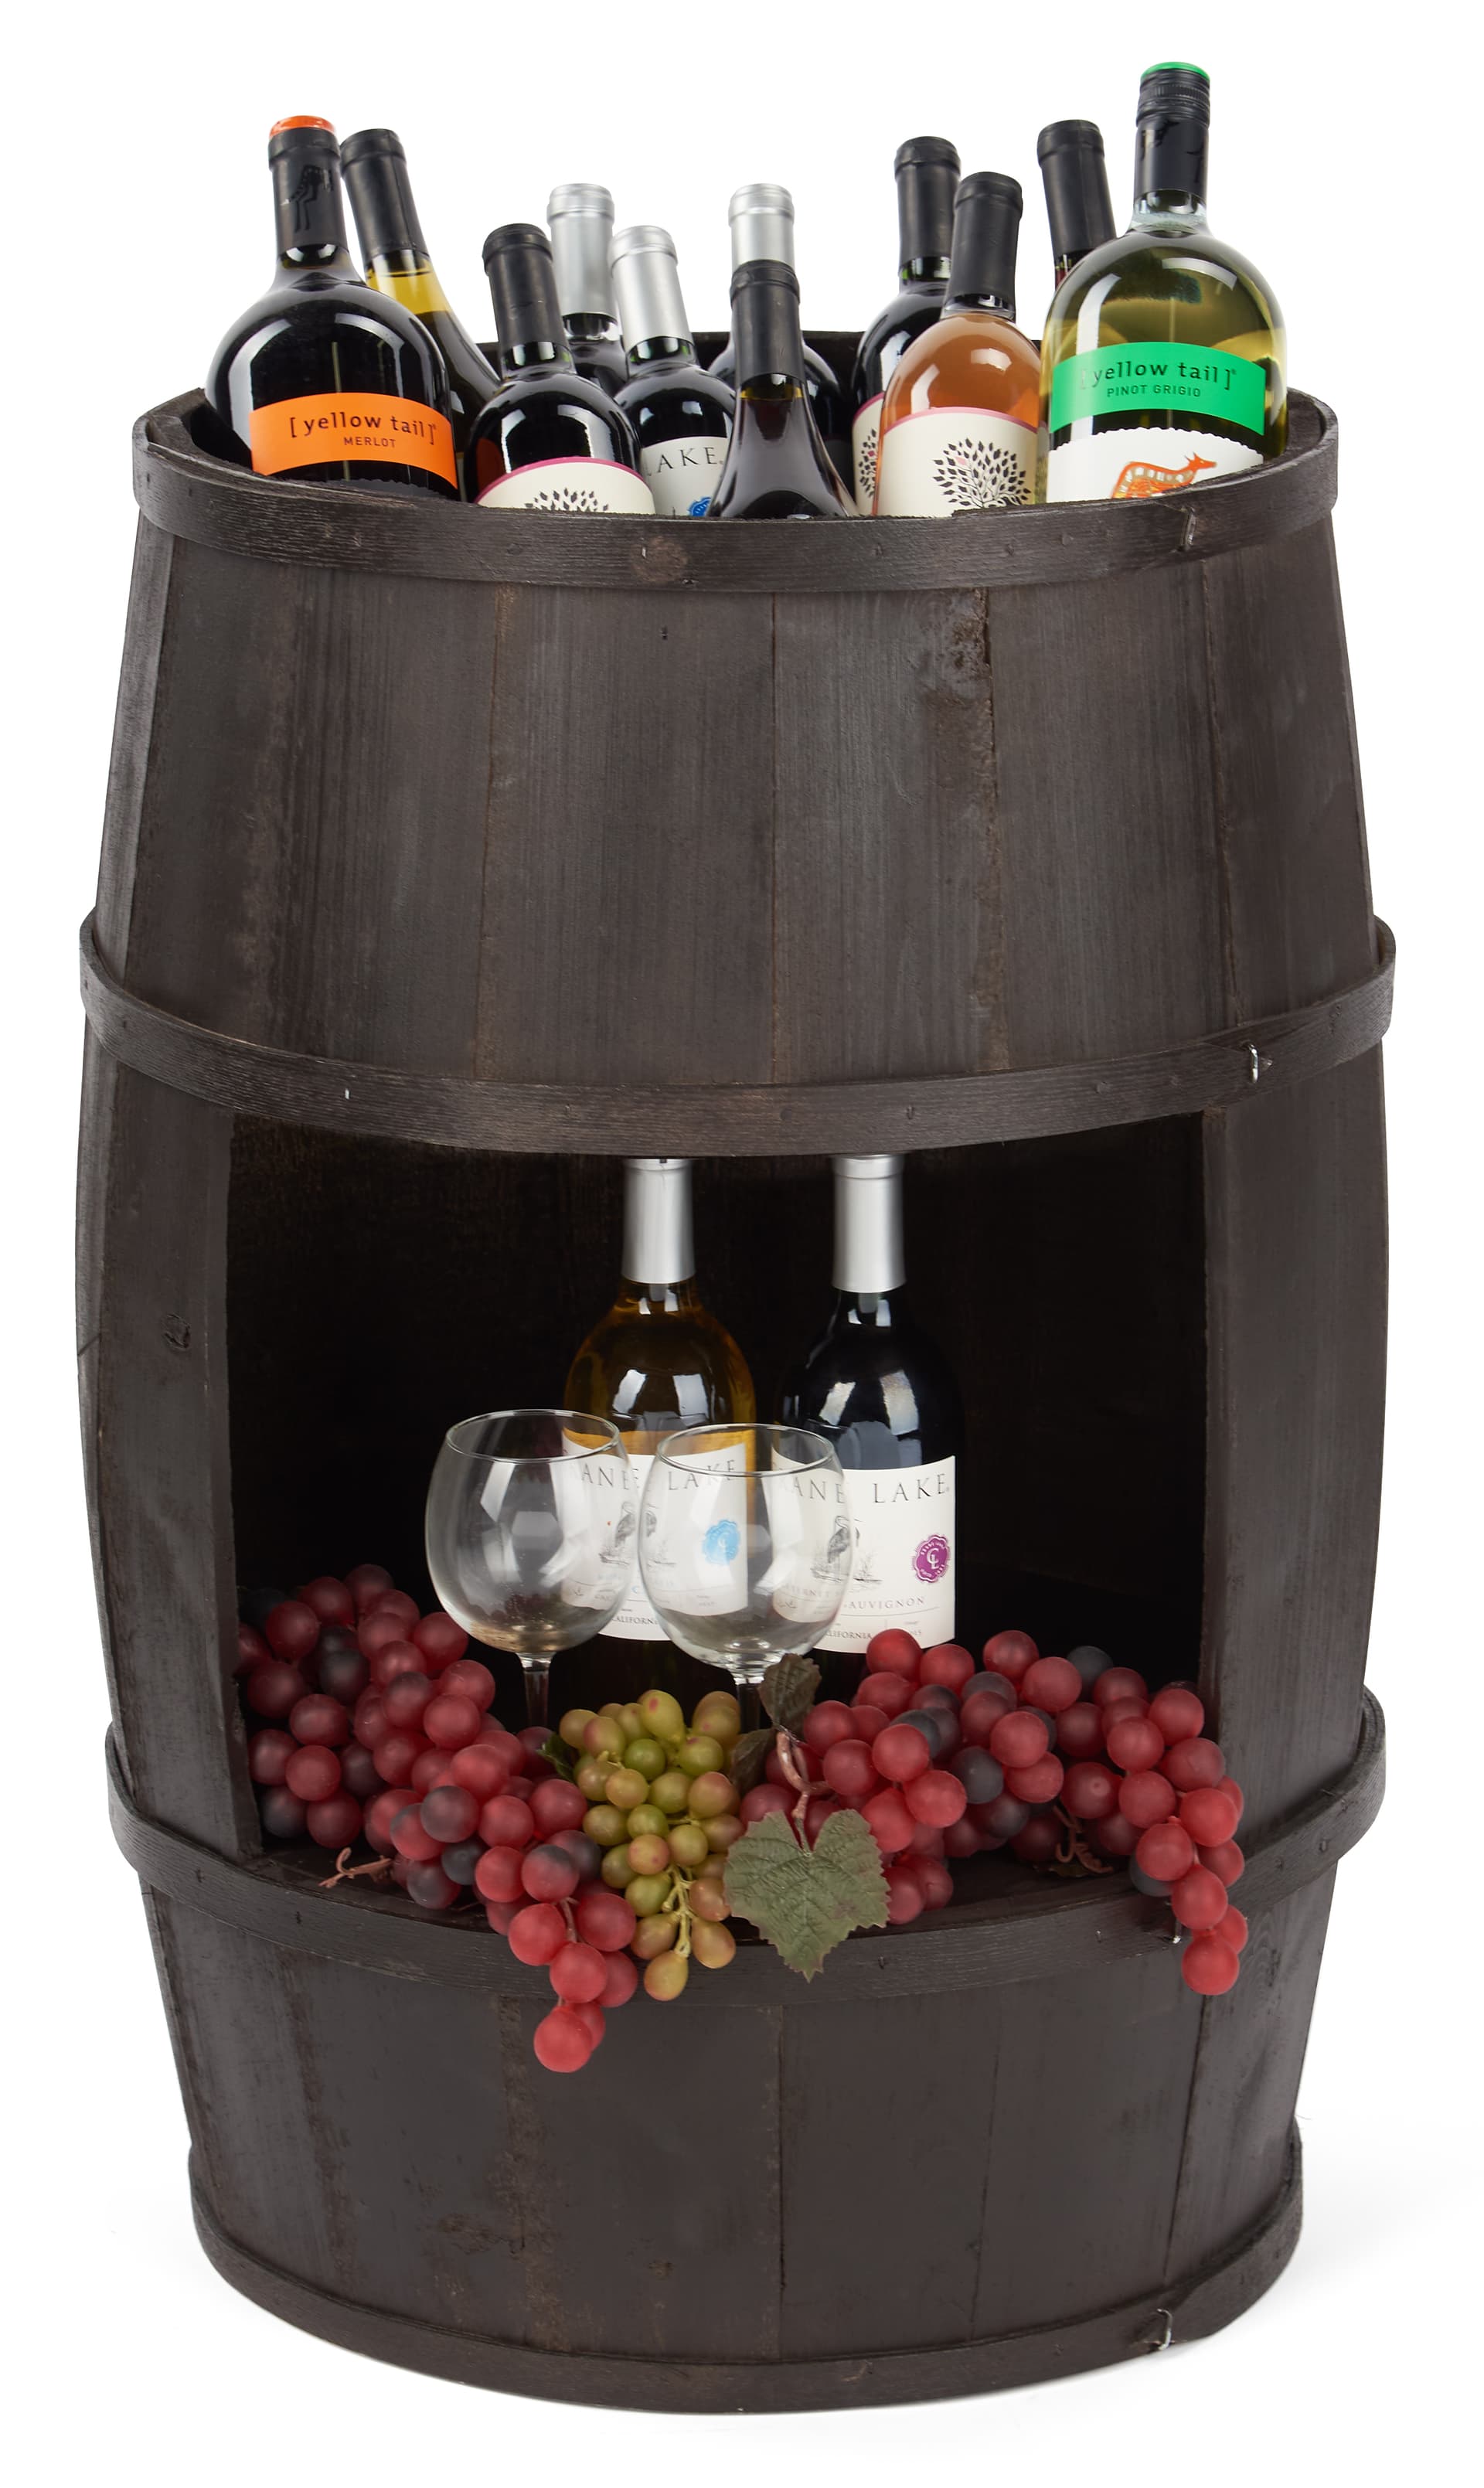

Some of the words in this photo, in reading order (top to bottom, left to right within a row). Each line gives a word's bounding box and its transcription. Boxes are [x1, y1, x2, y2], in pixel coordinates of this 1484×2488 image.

[1107, 384, 1147, 397] PINOT
[1153, 385, 1201, 397] GRIGIO
[344, 437, 397, 448] MERLOT
[872, 1473, 946, 1503] LAKE
